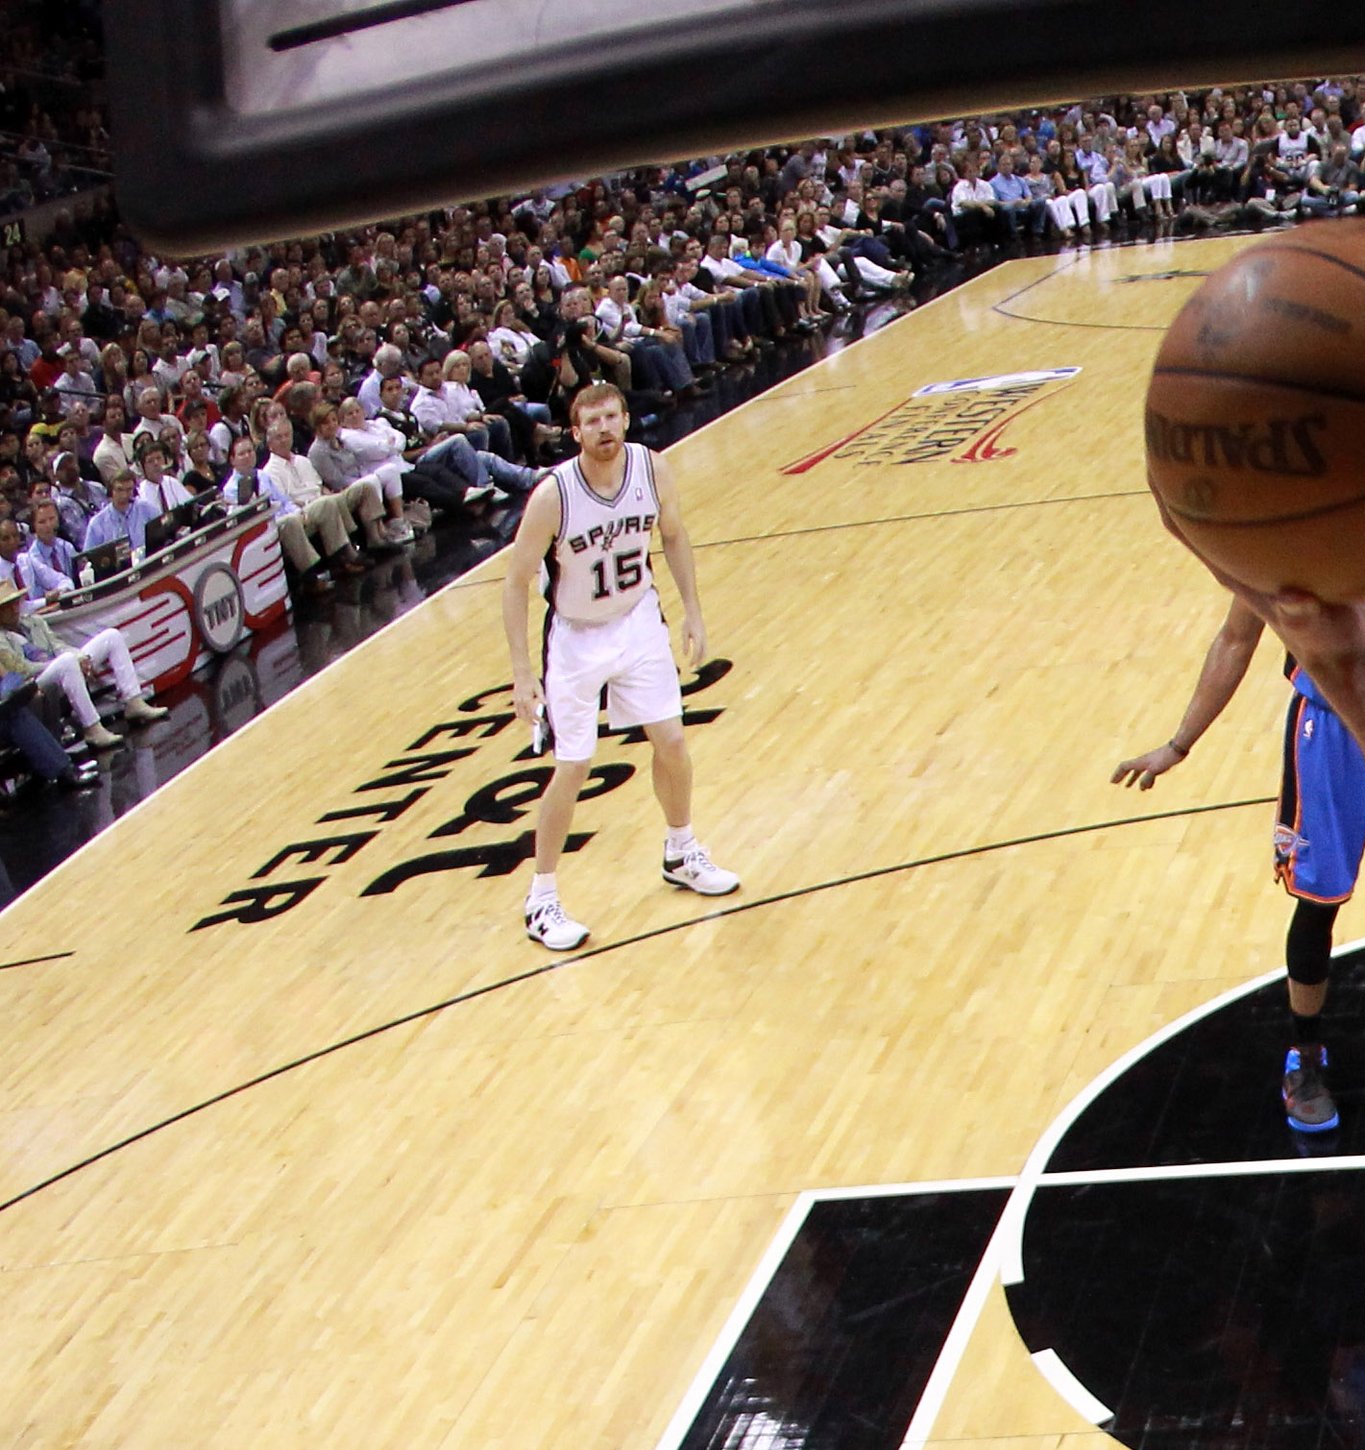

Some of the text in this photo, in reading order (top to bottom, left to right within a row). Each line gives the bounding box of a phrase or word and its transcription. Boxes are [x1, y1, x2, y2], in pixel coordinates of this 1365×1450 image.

[4, 222, 21, 246] 24
[890, 382, 1046, 466] WESTERN
[569, 513, 656, 553] SPURS
[590, 548, 644, 601] 15
[187, 683, 519, 933] CENTER
